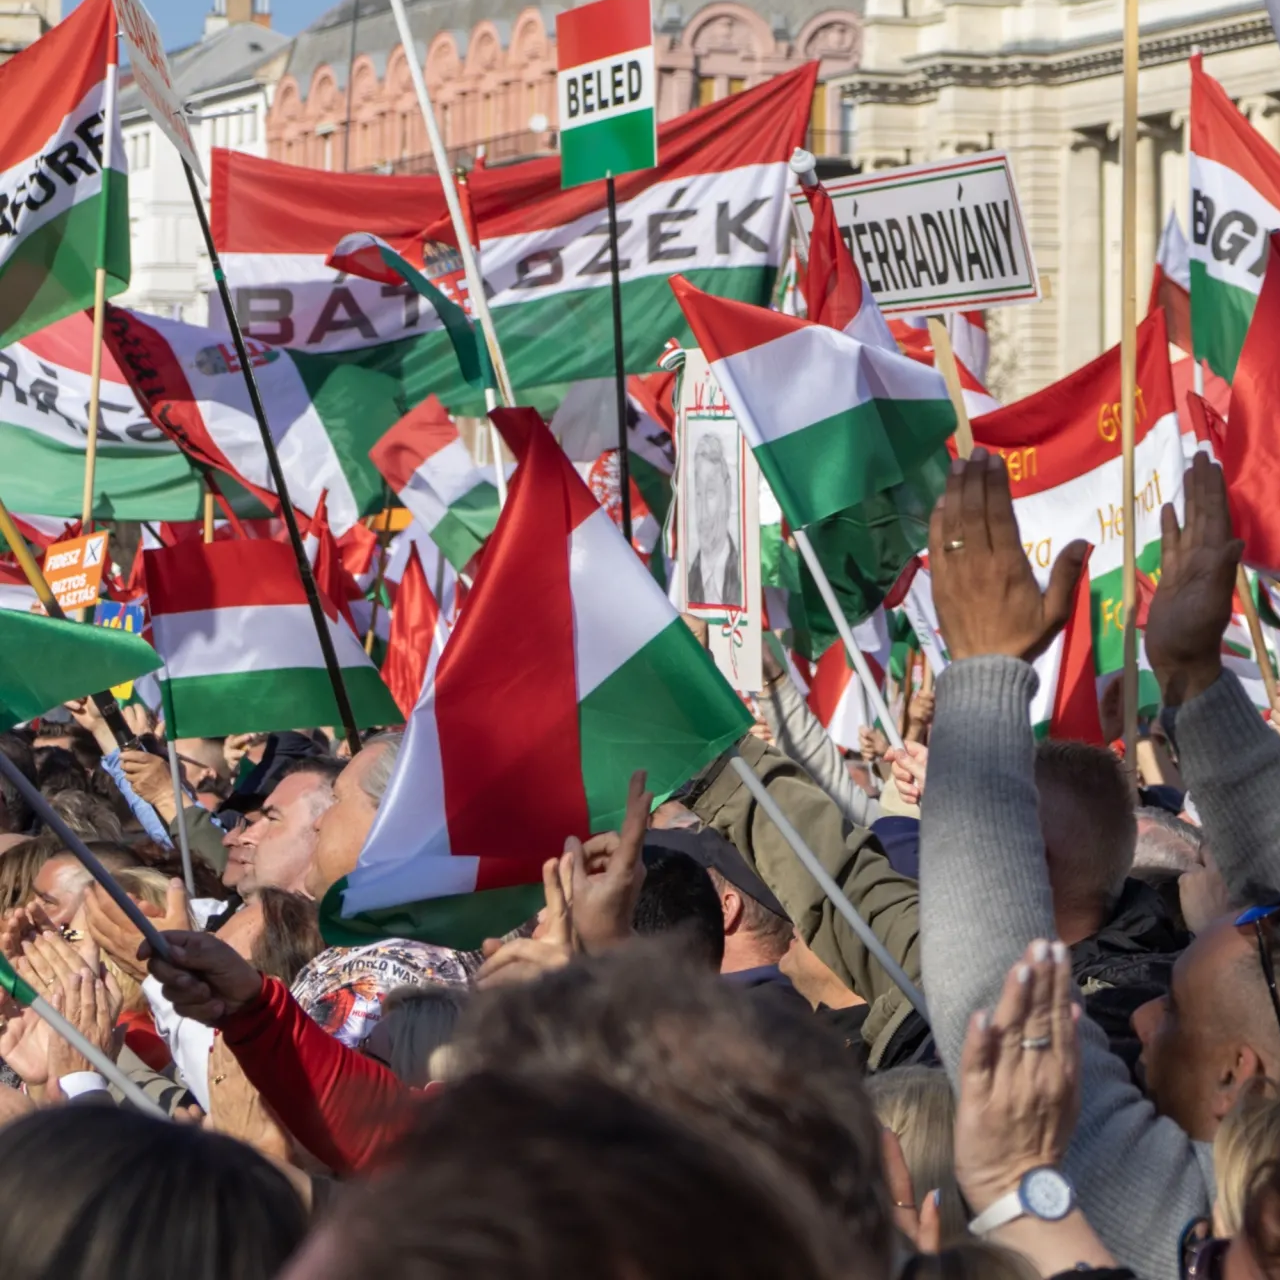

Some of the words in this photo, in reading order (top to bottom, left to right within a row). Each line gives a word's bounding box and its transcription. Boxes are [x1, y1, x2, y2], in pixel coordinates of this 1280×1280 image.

[567, 59, 642, 118] BELED
[838, 182, 1018, 293] ÉRRADVÁNY
[47, 548, 81, 572] FIDESZ
